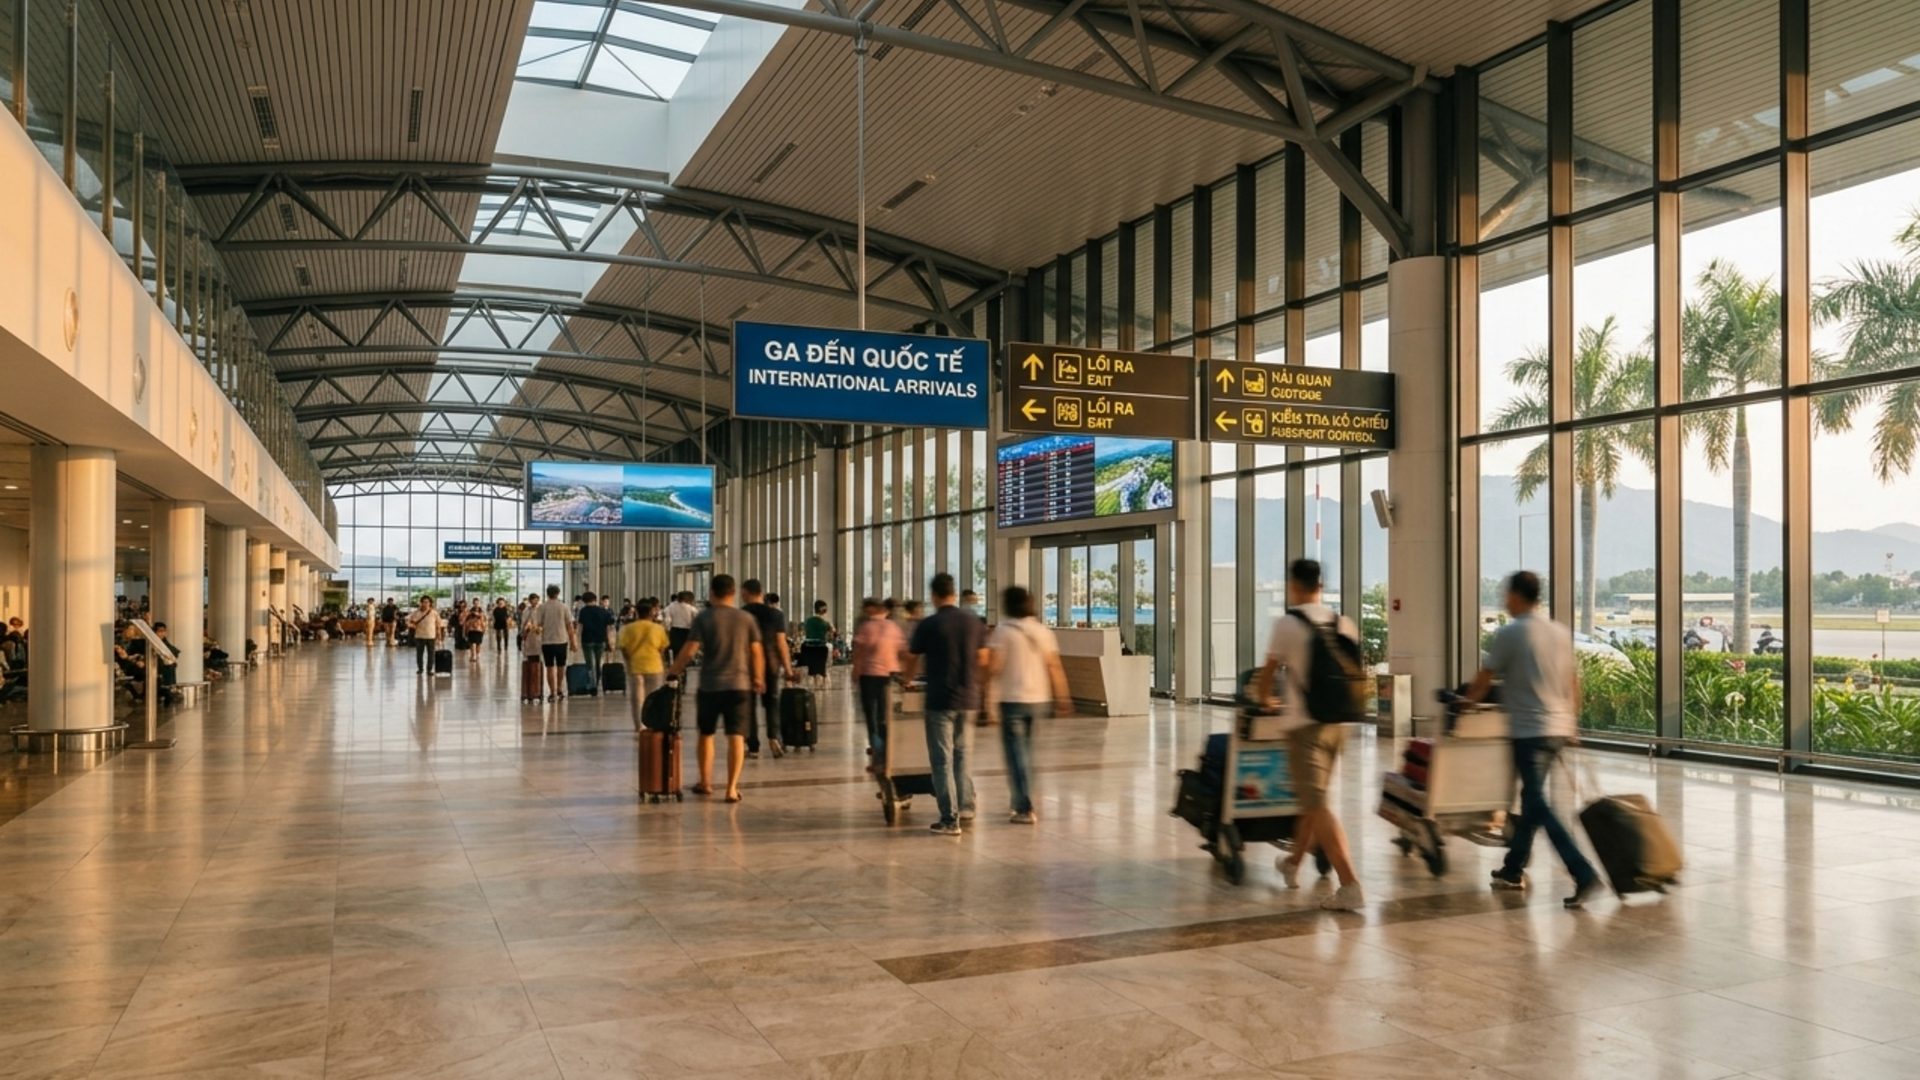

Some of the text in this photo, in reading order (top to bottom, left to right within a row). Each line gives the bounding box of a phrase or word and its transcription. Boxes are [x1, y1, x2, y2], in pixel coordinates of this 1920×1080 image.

[764, 338, 966, 373] GA ĐẾN QUỐC TẾ
[1114, 359, 1134, 373] RA
[748, 368, 977, 399] INTERNATIONAL ARRIVALS
[1114, 401, 1134, 415] RA
